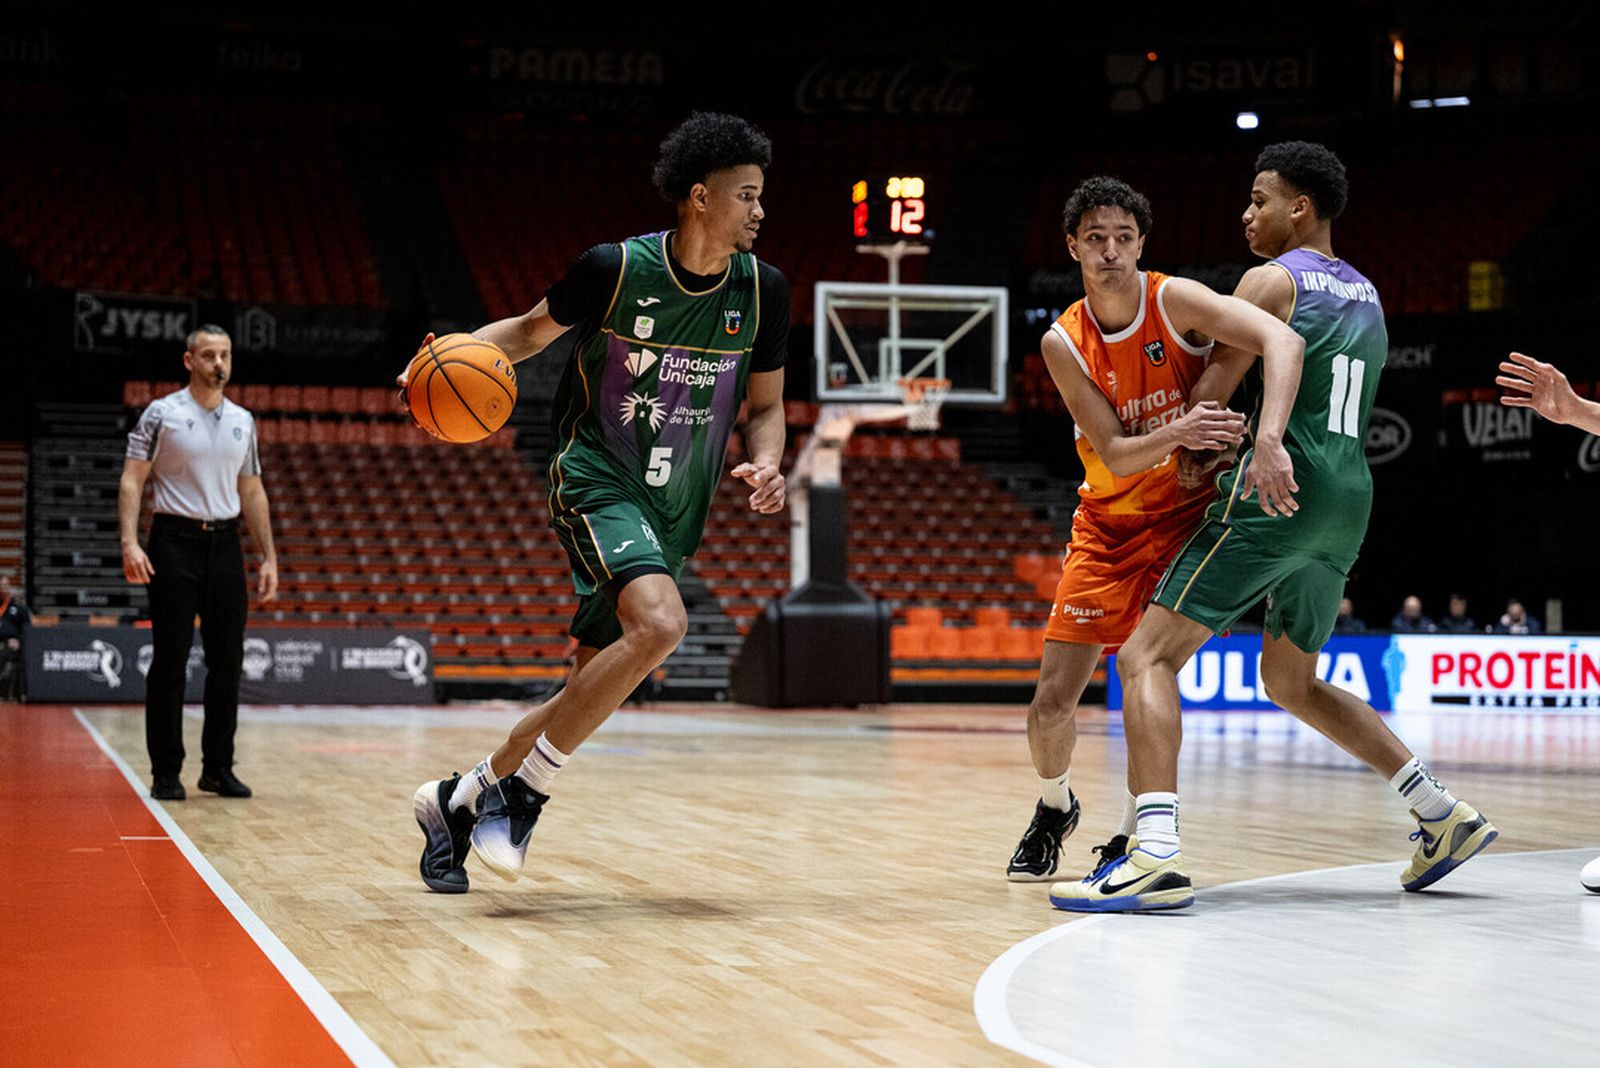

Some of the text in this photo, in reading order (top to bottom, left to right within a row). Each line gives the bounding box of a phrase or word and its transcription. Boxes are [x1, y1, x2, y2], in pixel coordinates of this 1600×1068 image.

[488, 48, 664, 85] PAMESA
[890, 199, 925, 233] 12
[101, 307, 189, 341] JYSK
[658, 367, 716, 389] Unicaja
[661, 353, 737, 373] Fundación
[1327, 353, 1365, 438] 11
[645, 447, 673, 487] 5
